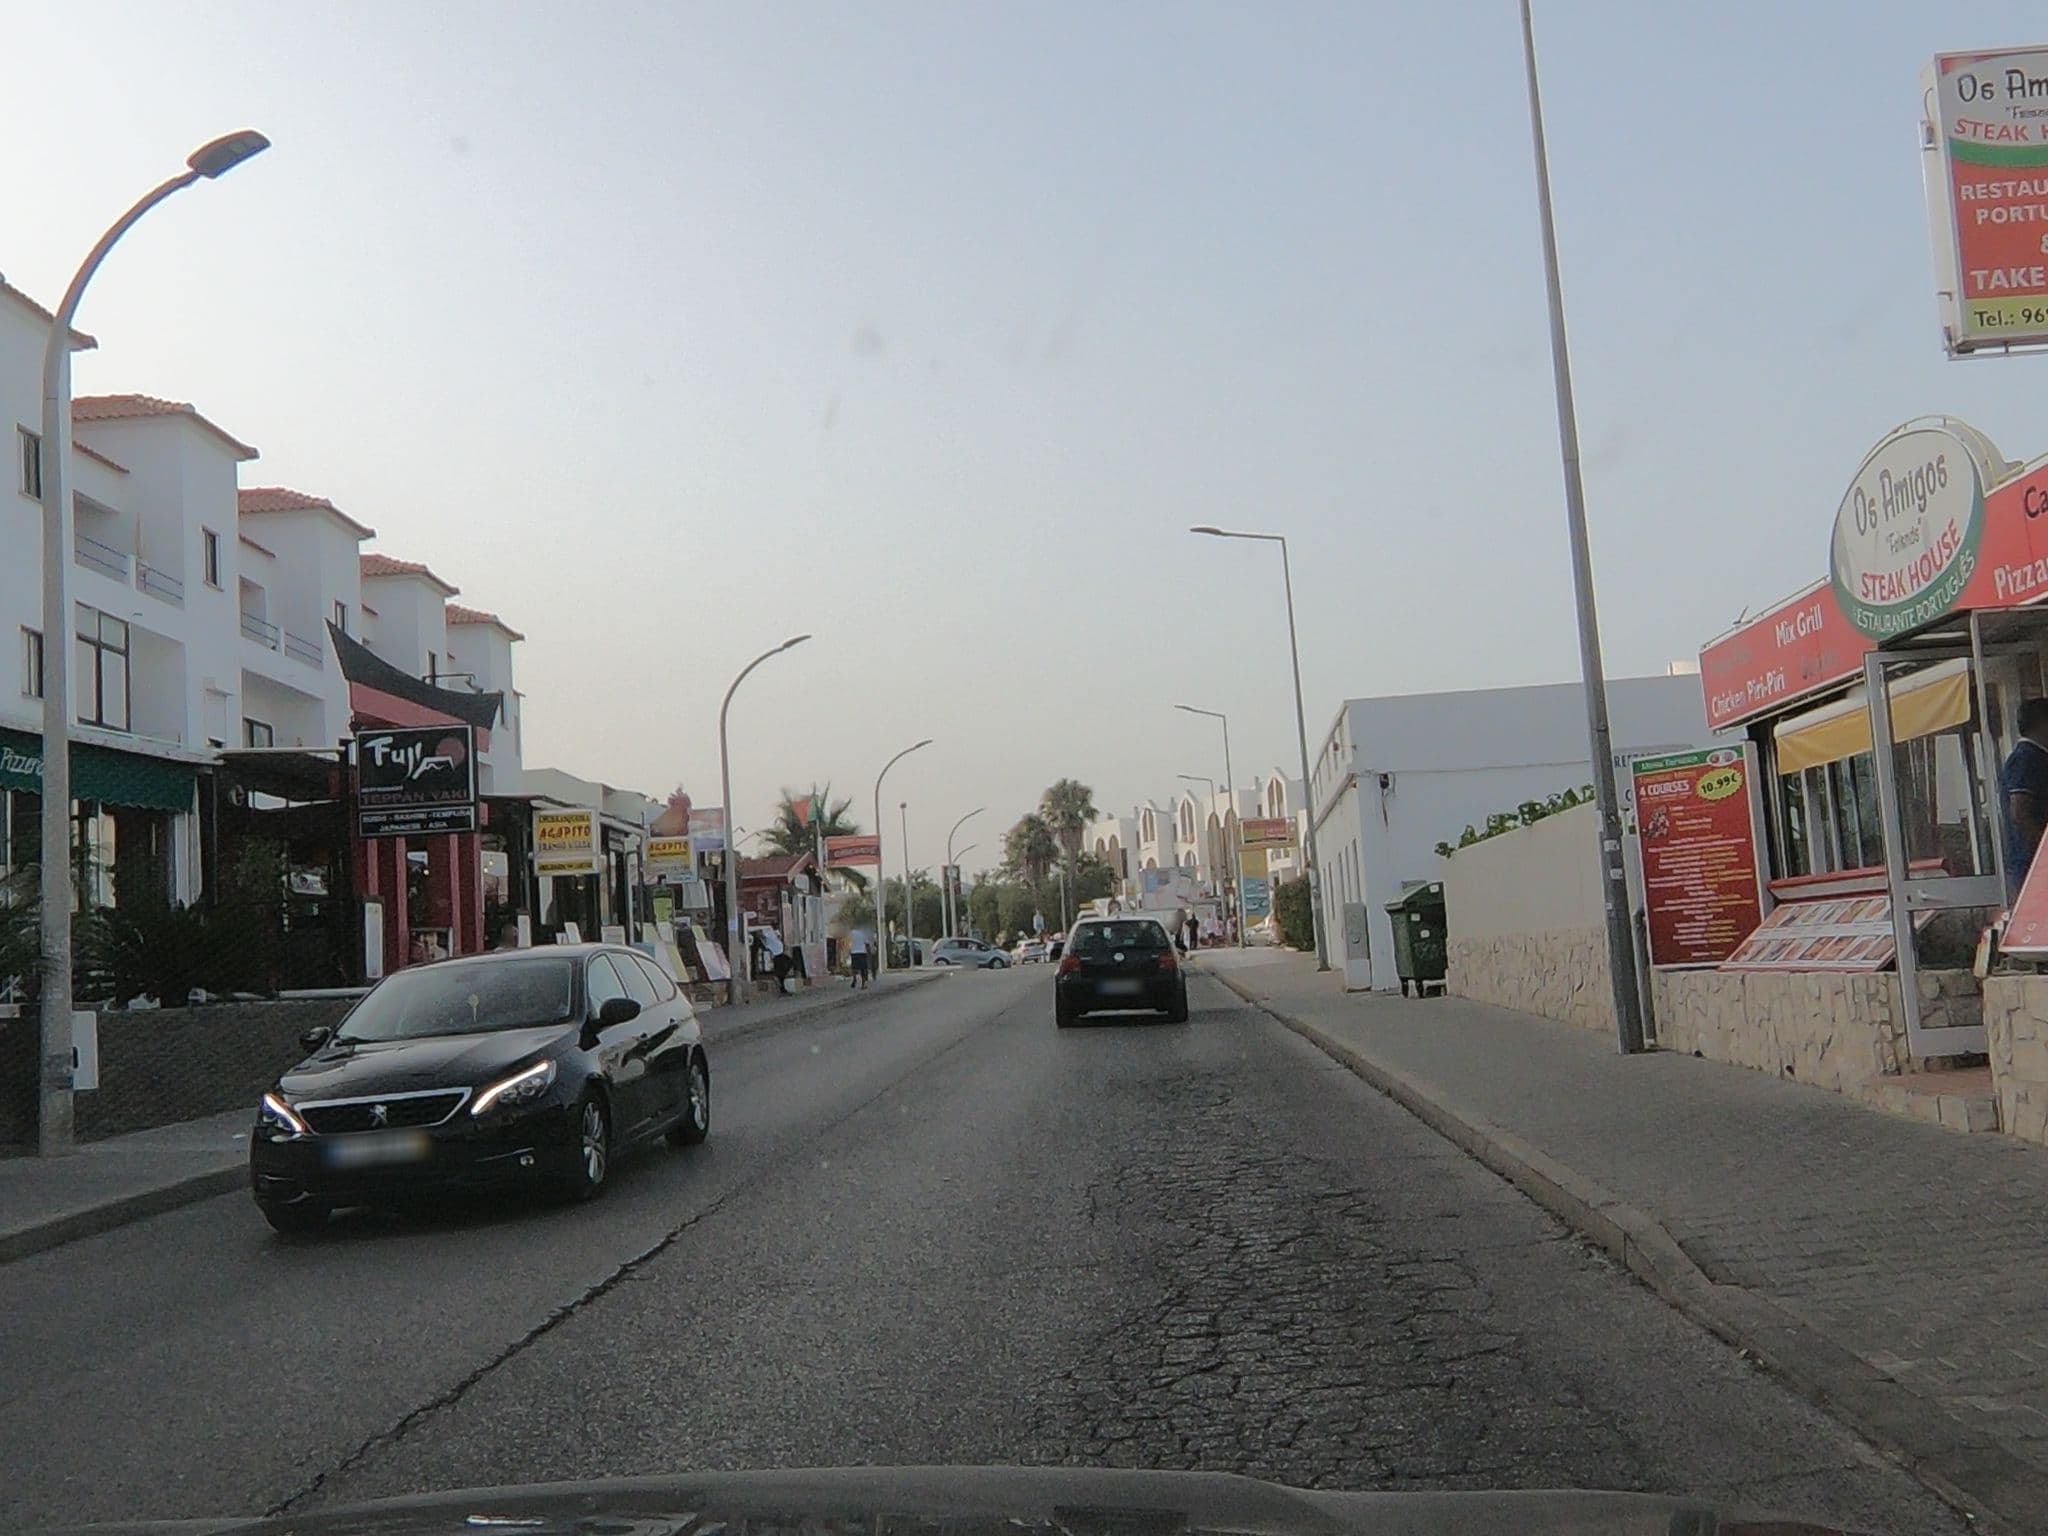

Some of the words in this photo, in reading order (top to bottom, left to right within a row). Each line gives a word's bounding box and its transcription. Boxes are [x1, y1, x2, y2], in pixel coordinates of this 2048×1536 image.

[1957, 74, 1994, 102] Os
[1954, 118, 2029, 142] STEAK
[1970, 266, 2045, 292] TAKE
[1974, 309, 2015, 327] Tel.:
[2021, 307, 2048, 324] 96
[1854, 486, 1877, 536] Os
[1881, 454, 1948, 522] Amigos
[1862, 572, 1907, 601] STEAK
[1908, 518, 1961, 593] HOUSE
[1776, 620, 1795, 648] Mix
[1796, 603, 1823, 638] Grill
[1711, 690, 1744, 718] Chicken
[540, 826, 591, 840] AGAPITO
